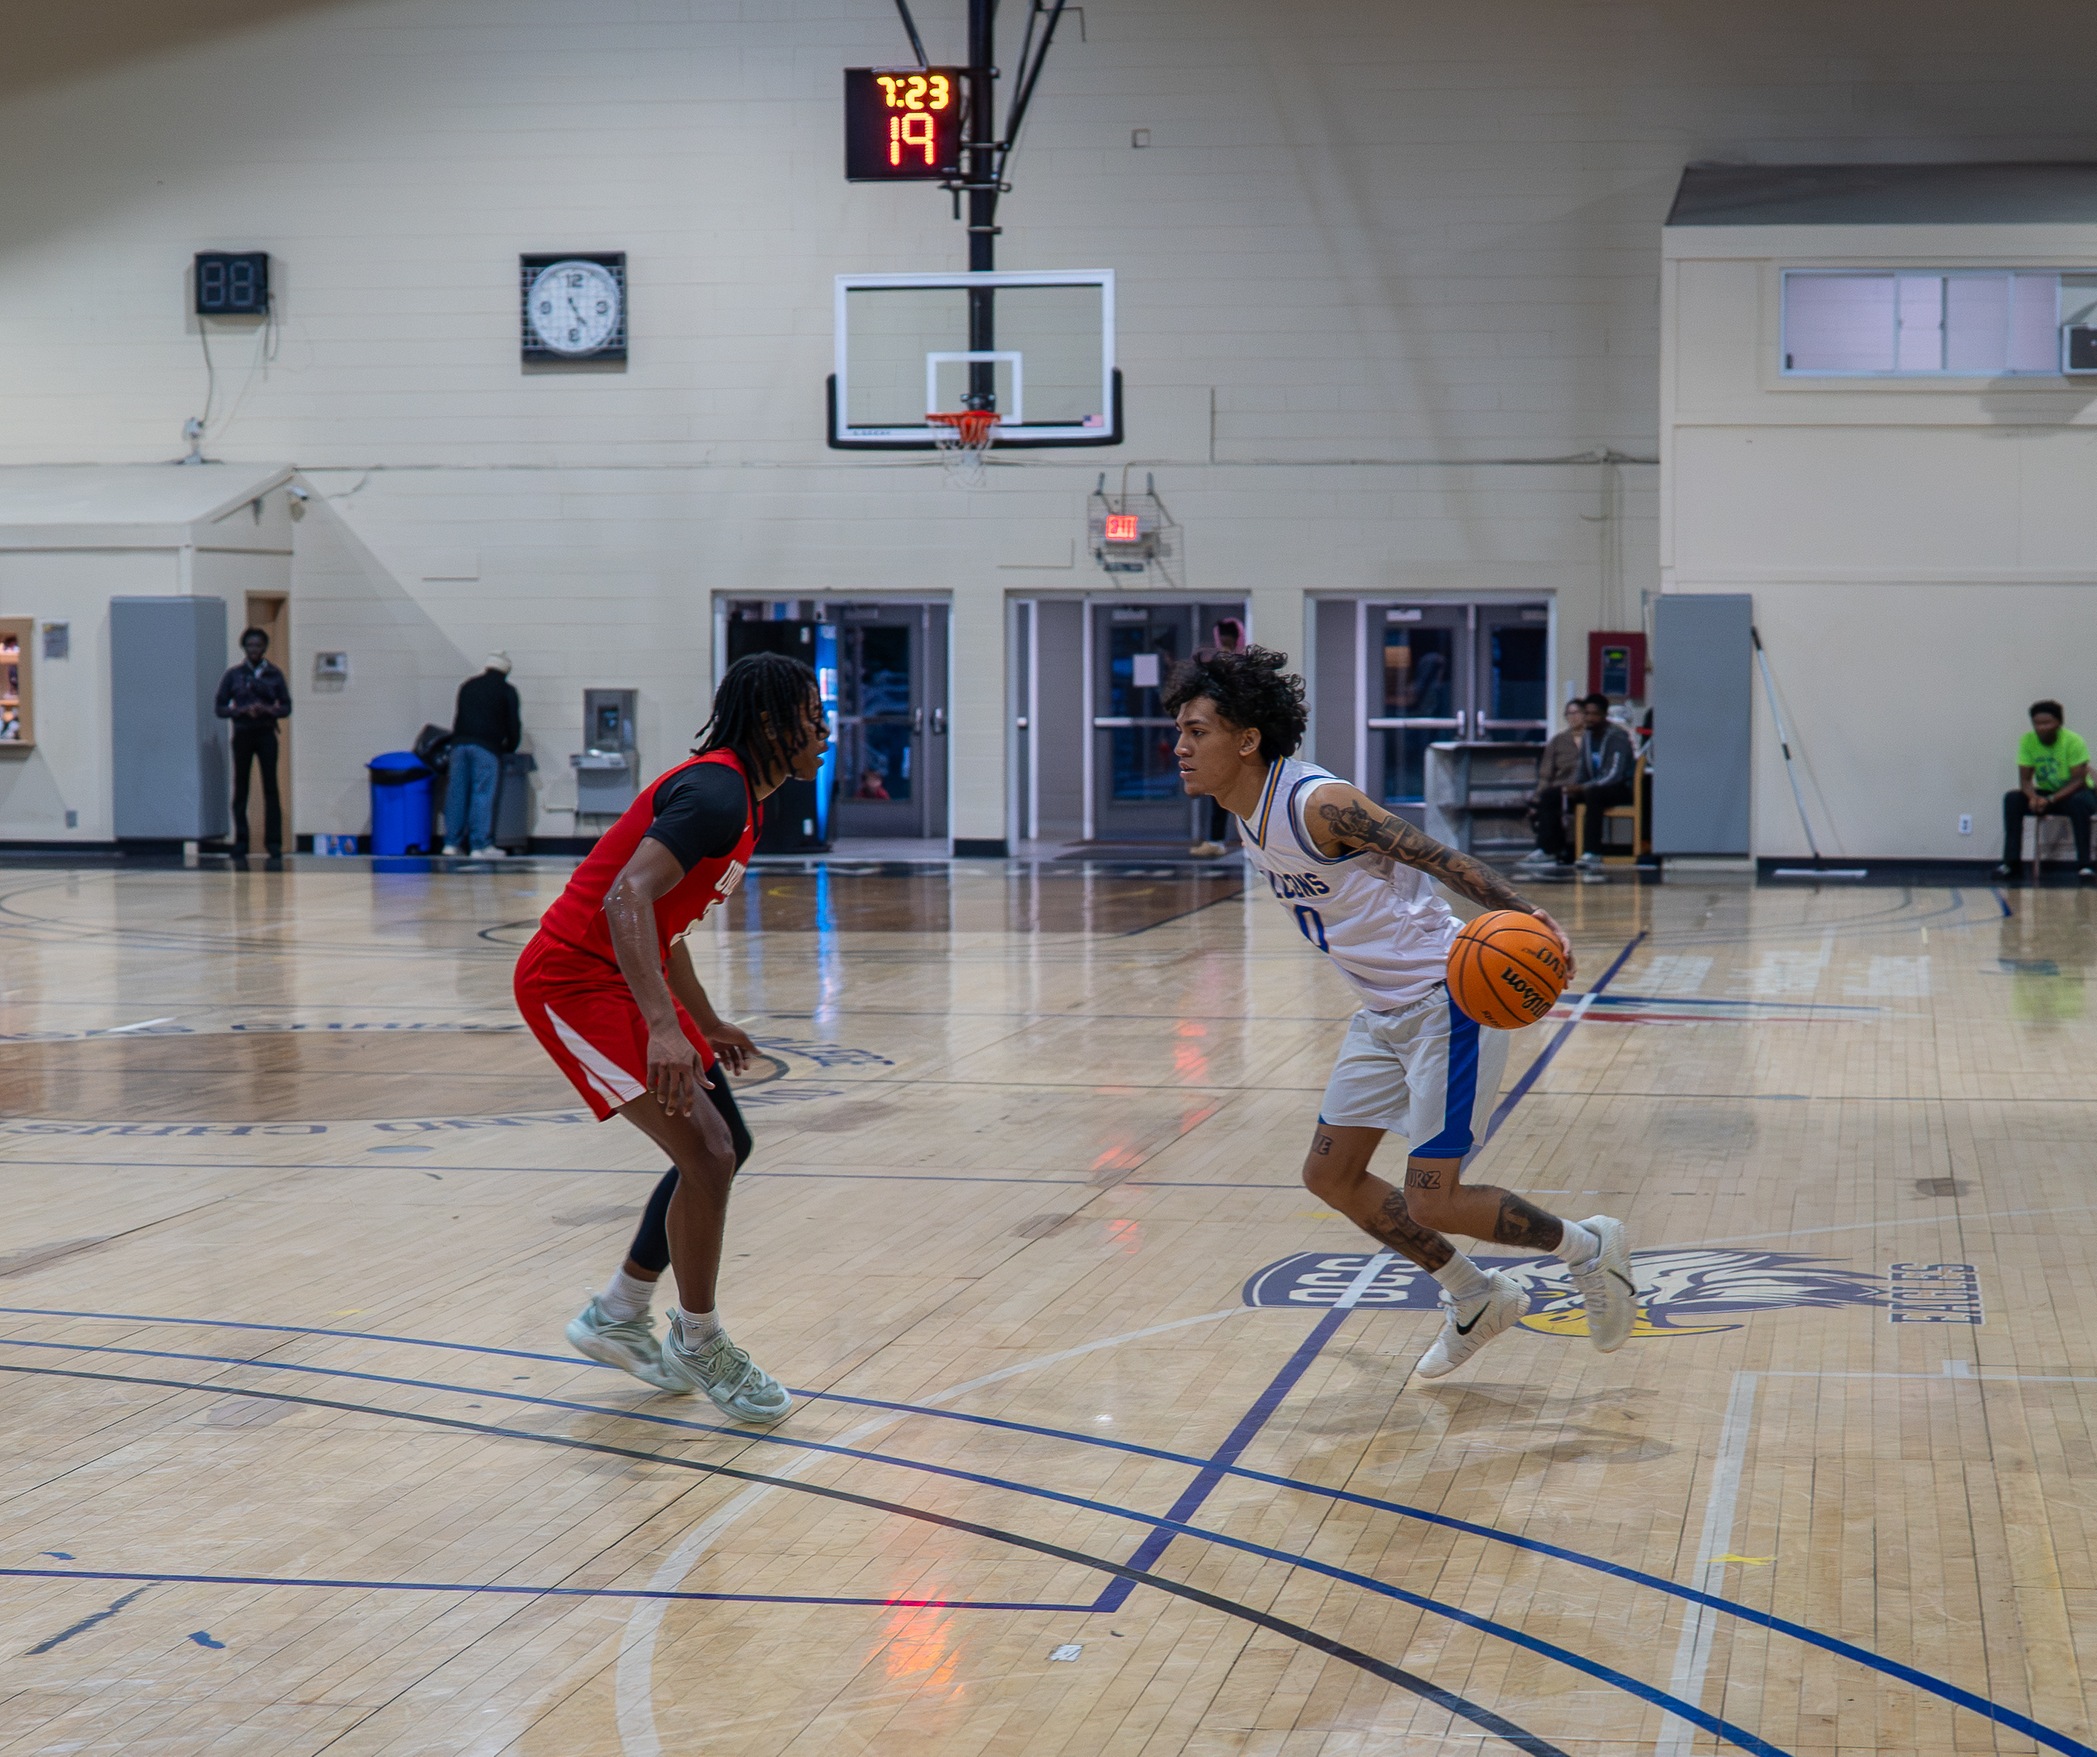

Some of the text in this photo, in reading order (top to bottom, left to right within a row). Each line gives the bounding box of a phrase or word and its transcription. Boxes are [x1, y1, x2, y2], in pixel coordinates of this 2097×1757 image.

[877, 75, 949, 110] 7:23
[889, 112, 934, 166] 19
[566, 273, 583, 288] 12
[1288, 1257, 1426, 1303] OCS
[1889, 1262, 1984, 1325] EAGLES
